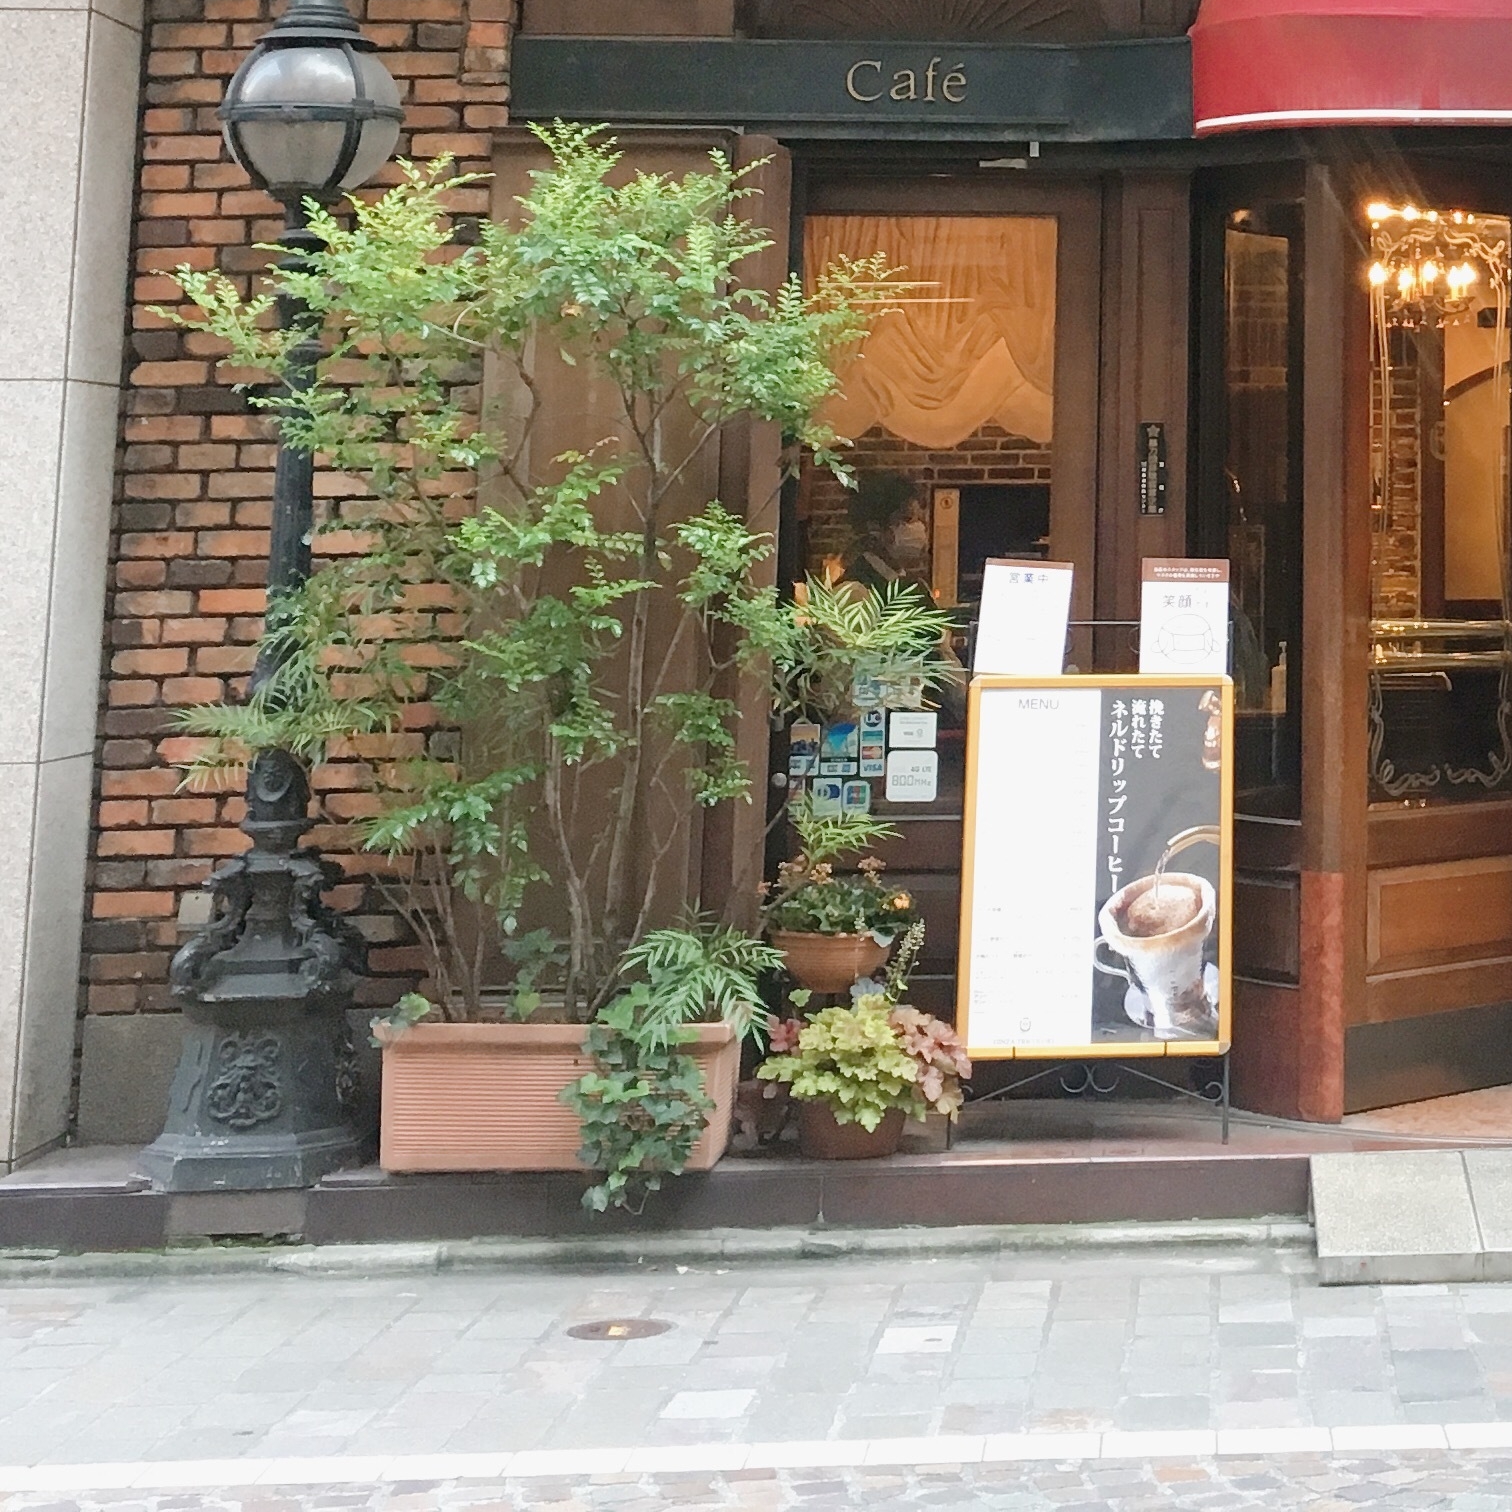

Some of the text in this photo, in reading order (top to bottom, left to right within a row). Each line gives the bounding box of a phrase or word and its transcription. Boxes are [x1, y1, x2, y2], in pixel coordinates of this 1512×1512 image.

[846, 57, 967, 102] Café
[1009, 572, 1048, 584] 営業中
[1018, 698, 1060, 710] MENU
[864, 764, 882, 772] VISA
[1107, 699, 1129, 894] ネルドリップコーヒー
